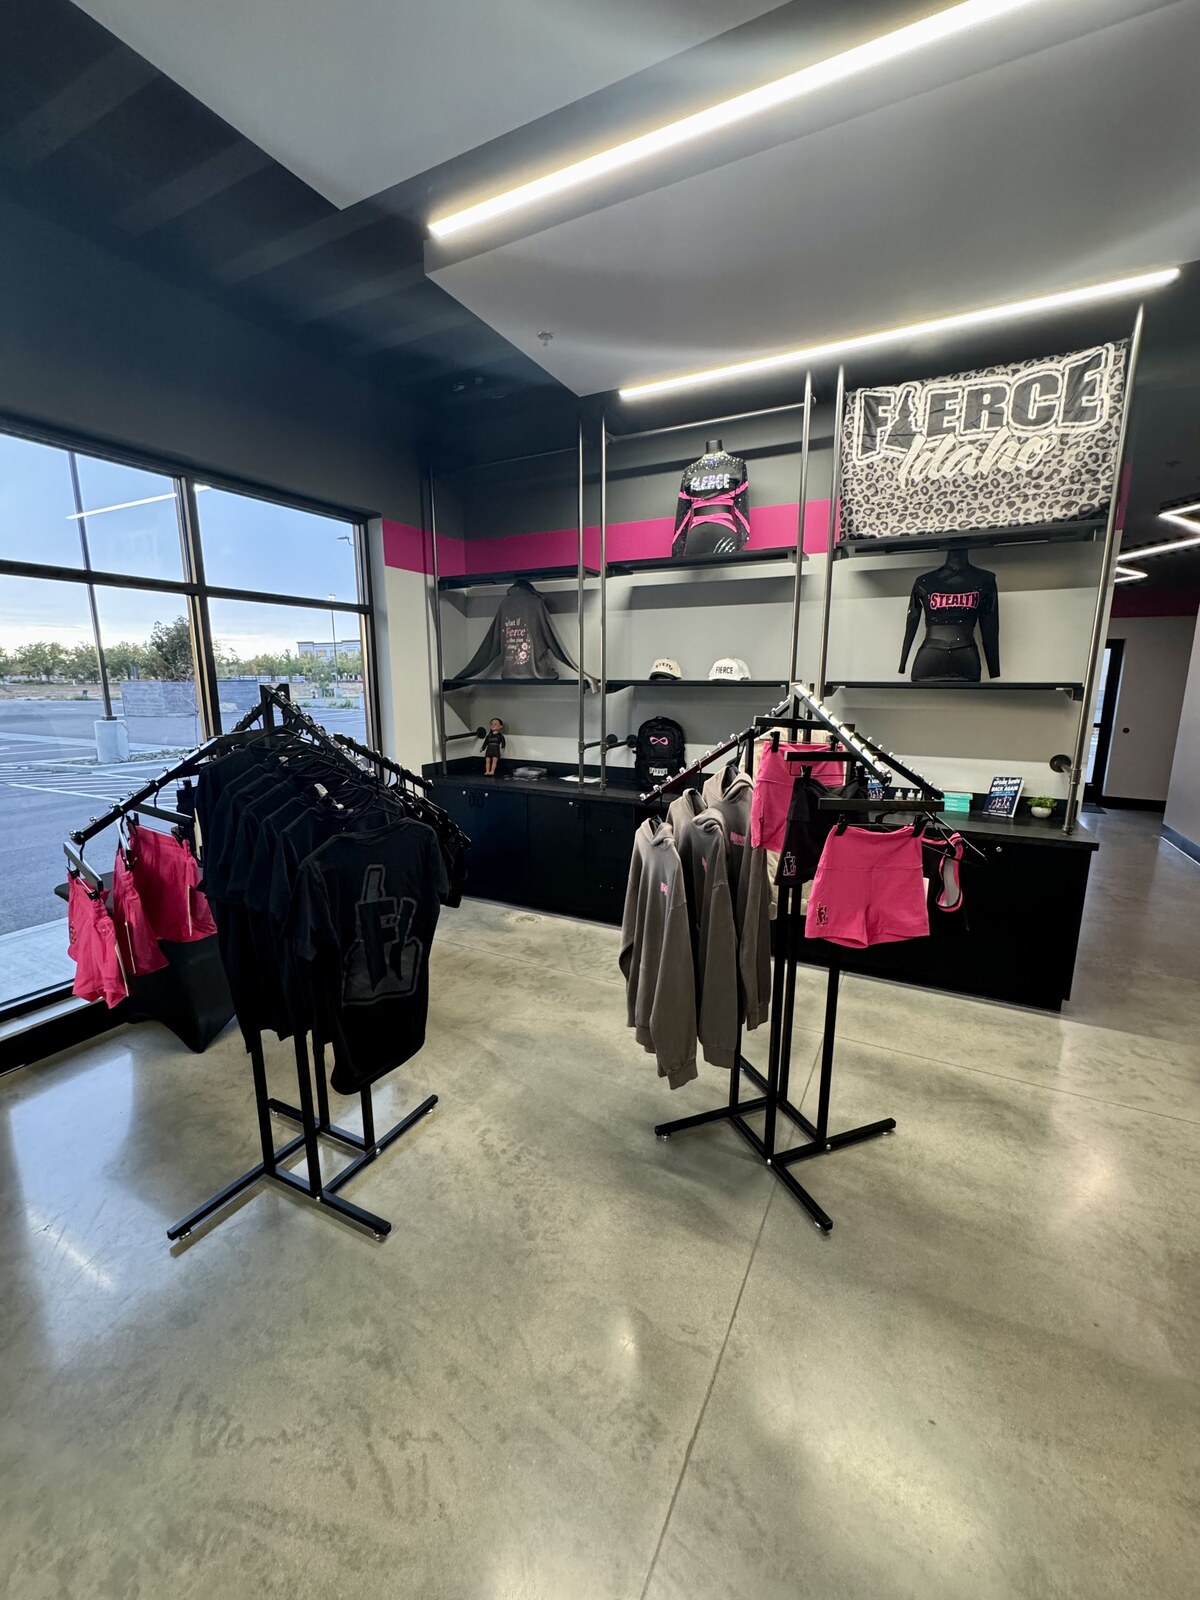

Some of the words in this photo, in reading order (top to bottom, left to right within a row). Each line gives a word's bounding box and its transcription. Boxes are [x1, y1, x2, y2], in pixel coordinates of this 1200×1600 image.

[854, 343, 1114, 463] FIERCE
[930, 592, 980, 610] STEALTH
[715, 666, 734, 675] FIERCE
